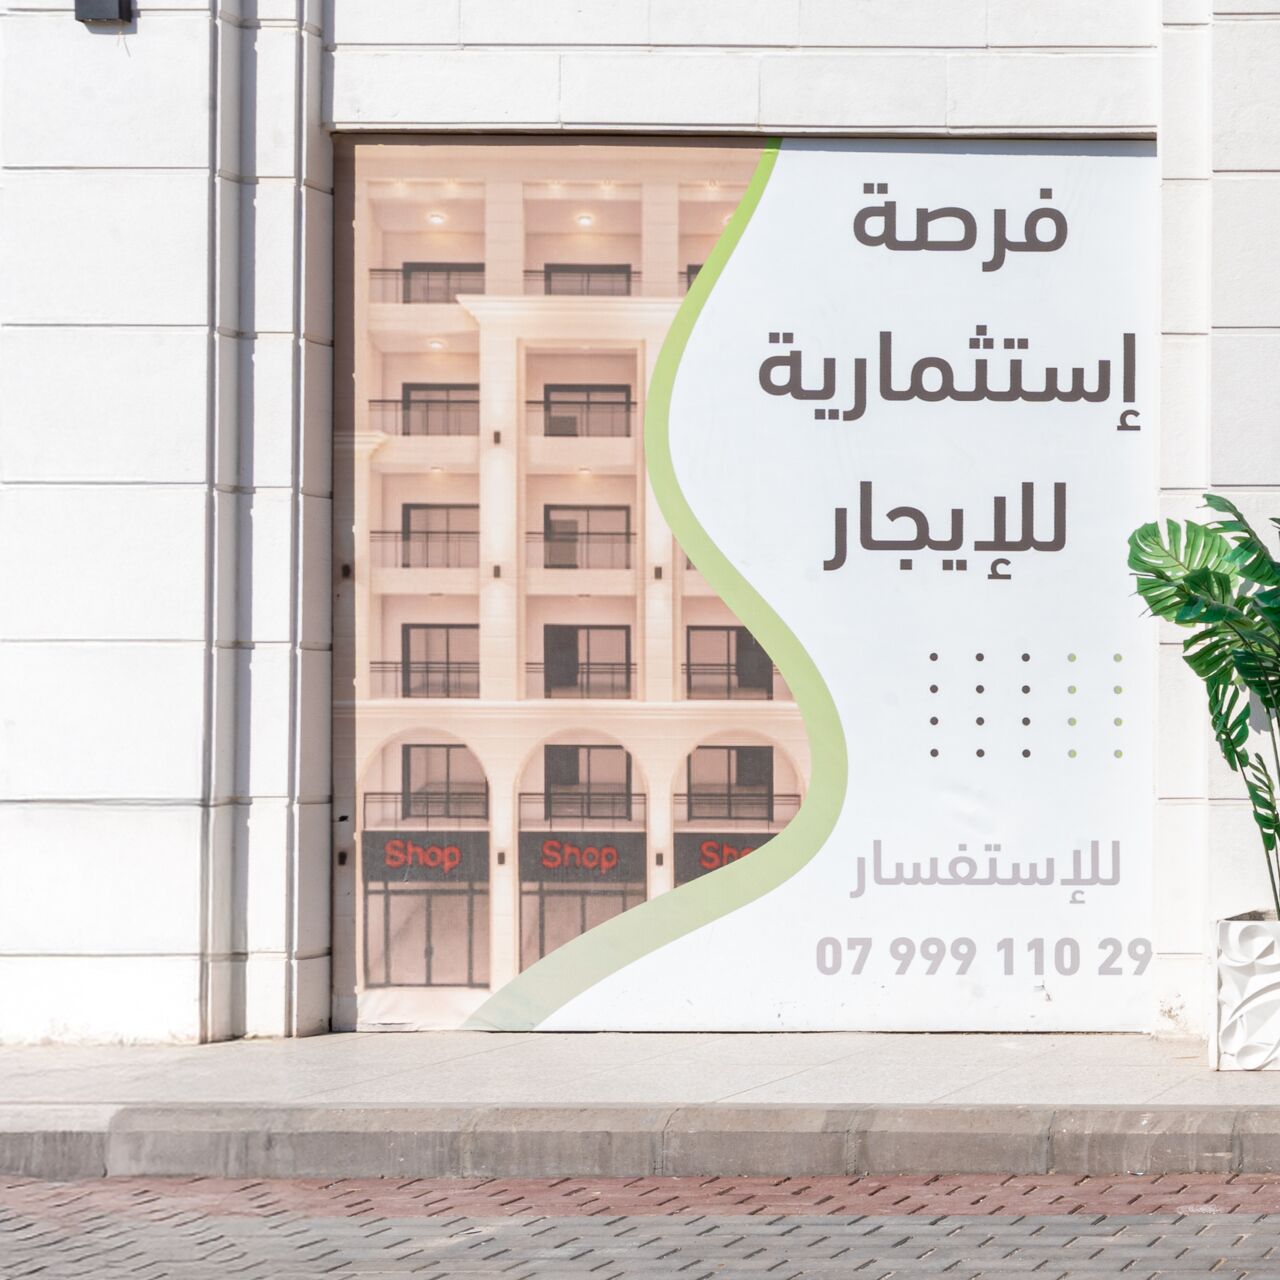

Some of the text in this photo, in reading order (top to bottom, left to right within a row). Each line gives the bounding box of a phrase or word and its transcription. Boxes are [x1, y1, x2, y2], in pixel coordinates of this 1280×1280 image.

[853, 183, 1068, 272] فرصة
[758, 324, 1141, 431] إستثمارية
[823, 481, 1067, 580] للإيجار
[384, 839, 463, 872] Shop
[541, 839, 619, 872] Shop
[699, 840, 754, 870] Sh
[849, 839, 1120, 904] للإستفسار
[816, 936, 1153, 976] 07 999 110 29
